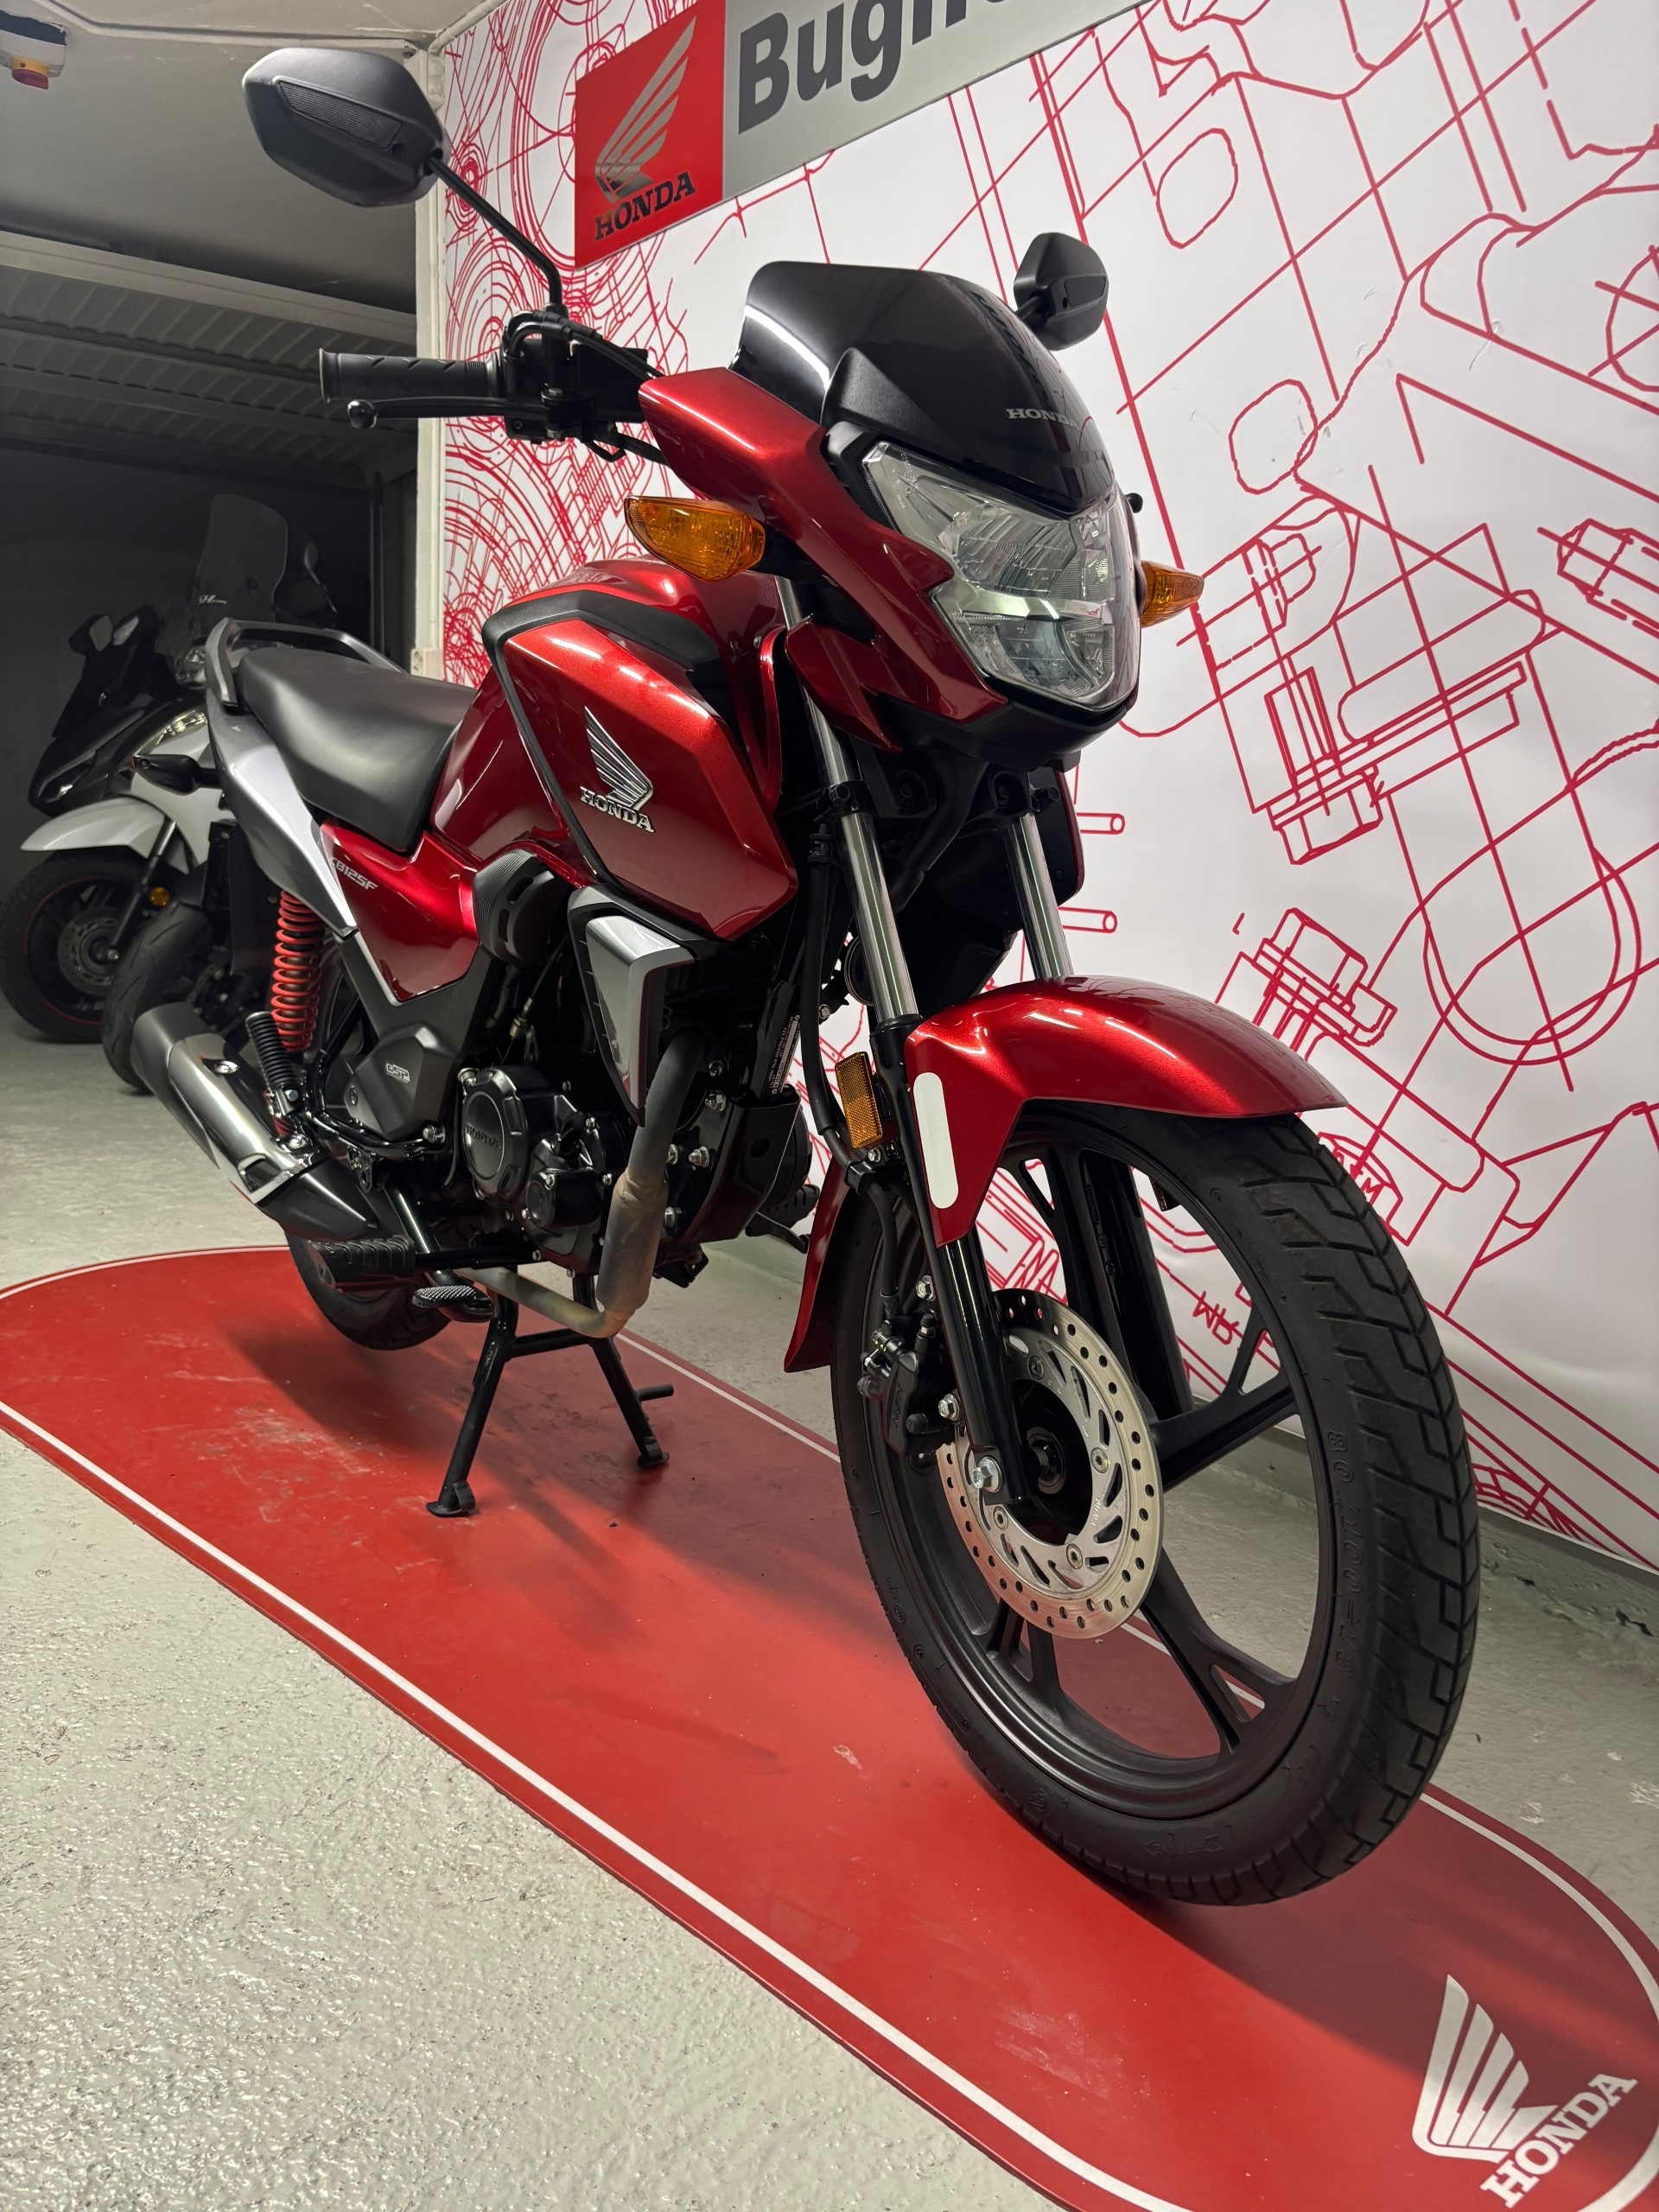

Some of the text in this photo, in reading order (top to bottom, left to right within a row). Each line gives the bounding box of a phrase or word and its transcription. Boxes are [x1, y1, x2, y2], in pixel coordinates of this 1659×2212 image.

[594, 171, 696, 241] HONDA
[1006, 408, 1082, 432] HONDA
[580, 785, 655, 833] HONDA
[1479, 2074, 1638, 2209] HONDA
